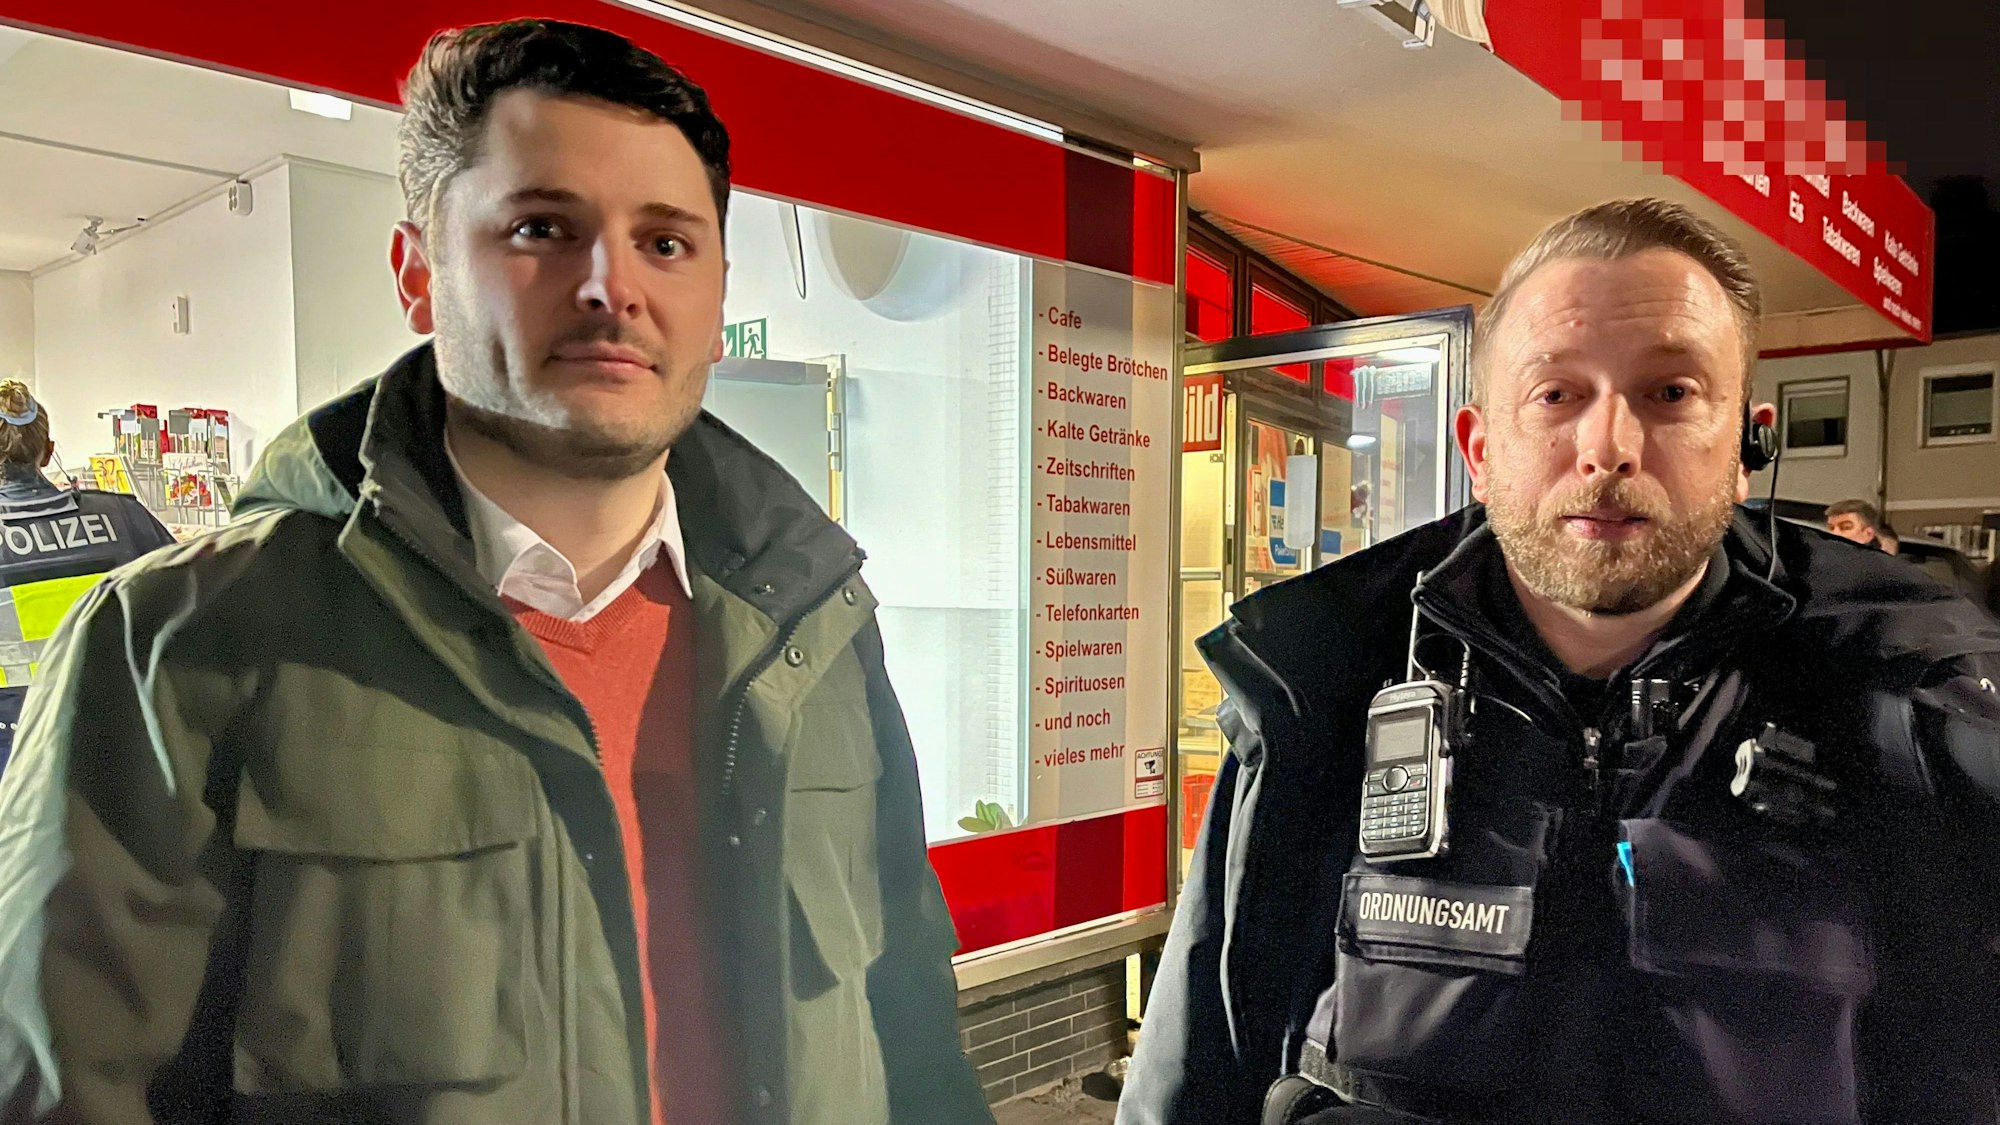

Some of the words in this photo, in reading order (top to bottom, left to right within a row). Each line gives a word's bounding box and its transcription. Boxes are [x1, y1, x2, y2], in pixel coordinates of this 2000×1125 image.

[1789, 190, 1804, 224] Eis
[1048, 306, 1082, 330] Cafe
[1047, 343, 1104, 373] Belegte
[1107, 354, 1168, 382] Brötchen
[1047, 381, 1127, 410] Backwaren
[1047, 418, 1085, 441] Kalte
[1088, 424, 1151, 449] Getränke
[1046, 456, 1136, 482] Zeitschriften
[1046, 493, 1131, 517] Tabakwaren
[1046, 530, 1137, 552] Lebensmittel
[1045, 567, 1117, 587] Süßwaren
[1045, 603, 1140, 622] Telefonkarten
[1044, 639, 1123, 663] Spielwaren
[1044, 674, 1125, 699] Spirituosen
[1044, 711, 1072, 731] und
[1076, 707, 1111, 729] noch
[1044, 746, 1086, 768] vieles
[1090, 741, 1126, 762] mehr
[1359, 892, 1509, 935] ORDNUNGSAMT
